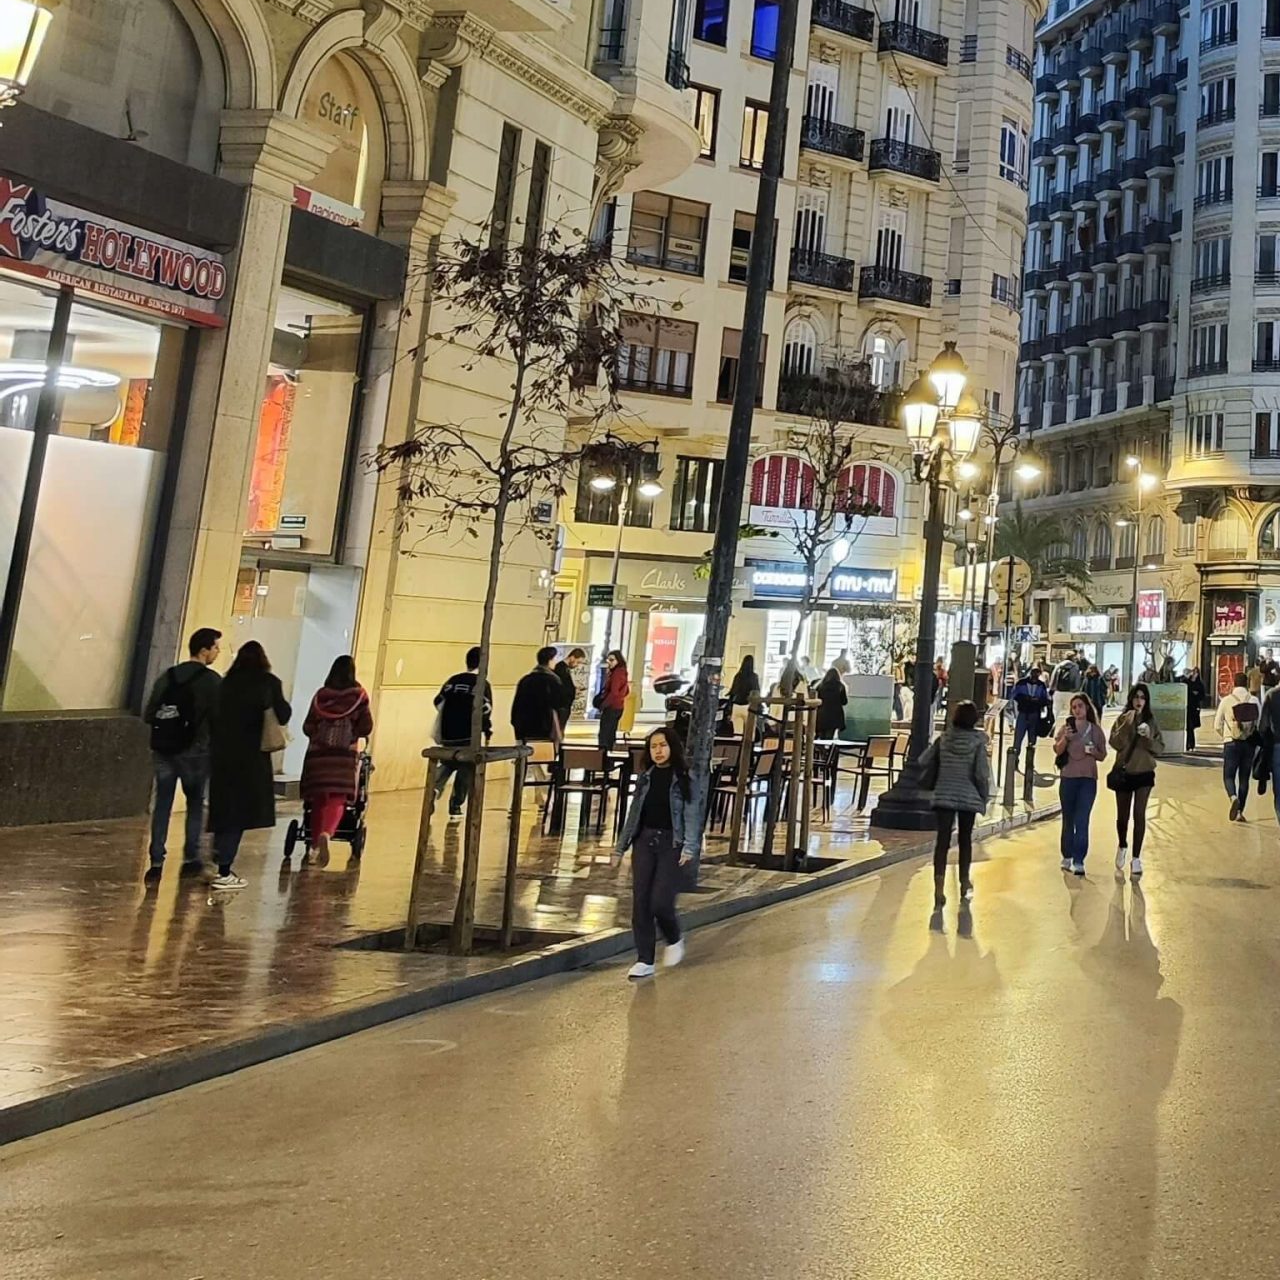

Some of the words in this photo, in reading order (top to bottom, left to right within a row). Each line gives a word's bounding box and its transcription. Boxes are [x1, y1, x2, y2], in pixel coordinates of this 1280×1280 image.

[318, 92, 360, 131] Staff
[0, 197, 81, 251] Foster's
[79, 222, 226, 300] HOLLYWOOD
[45, 270, 91, 291] AMERICAN
[93, 283, 146, 306] RESTAURANT
[147, 297, 170, 313] SINCE
[641, 568, 686, 591] Clarks
